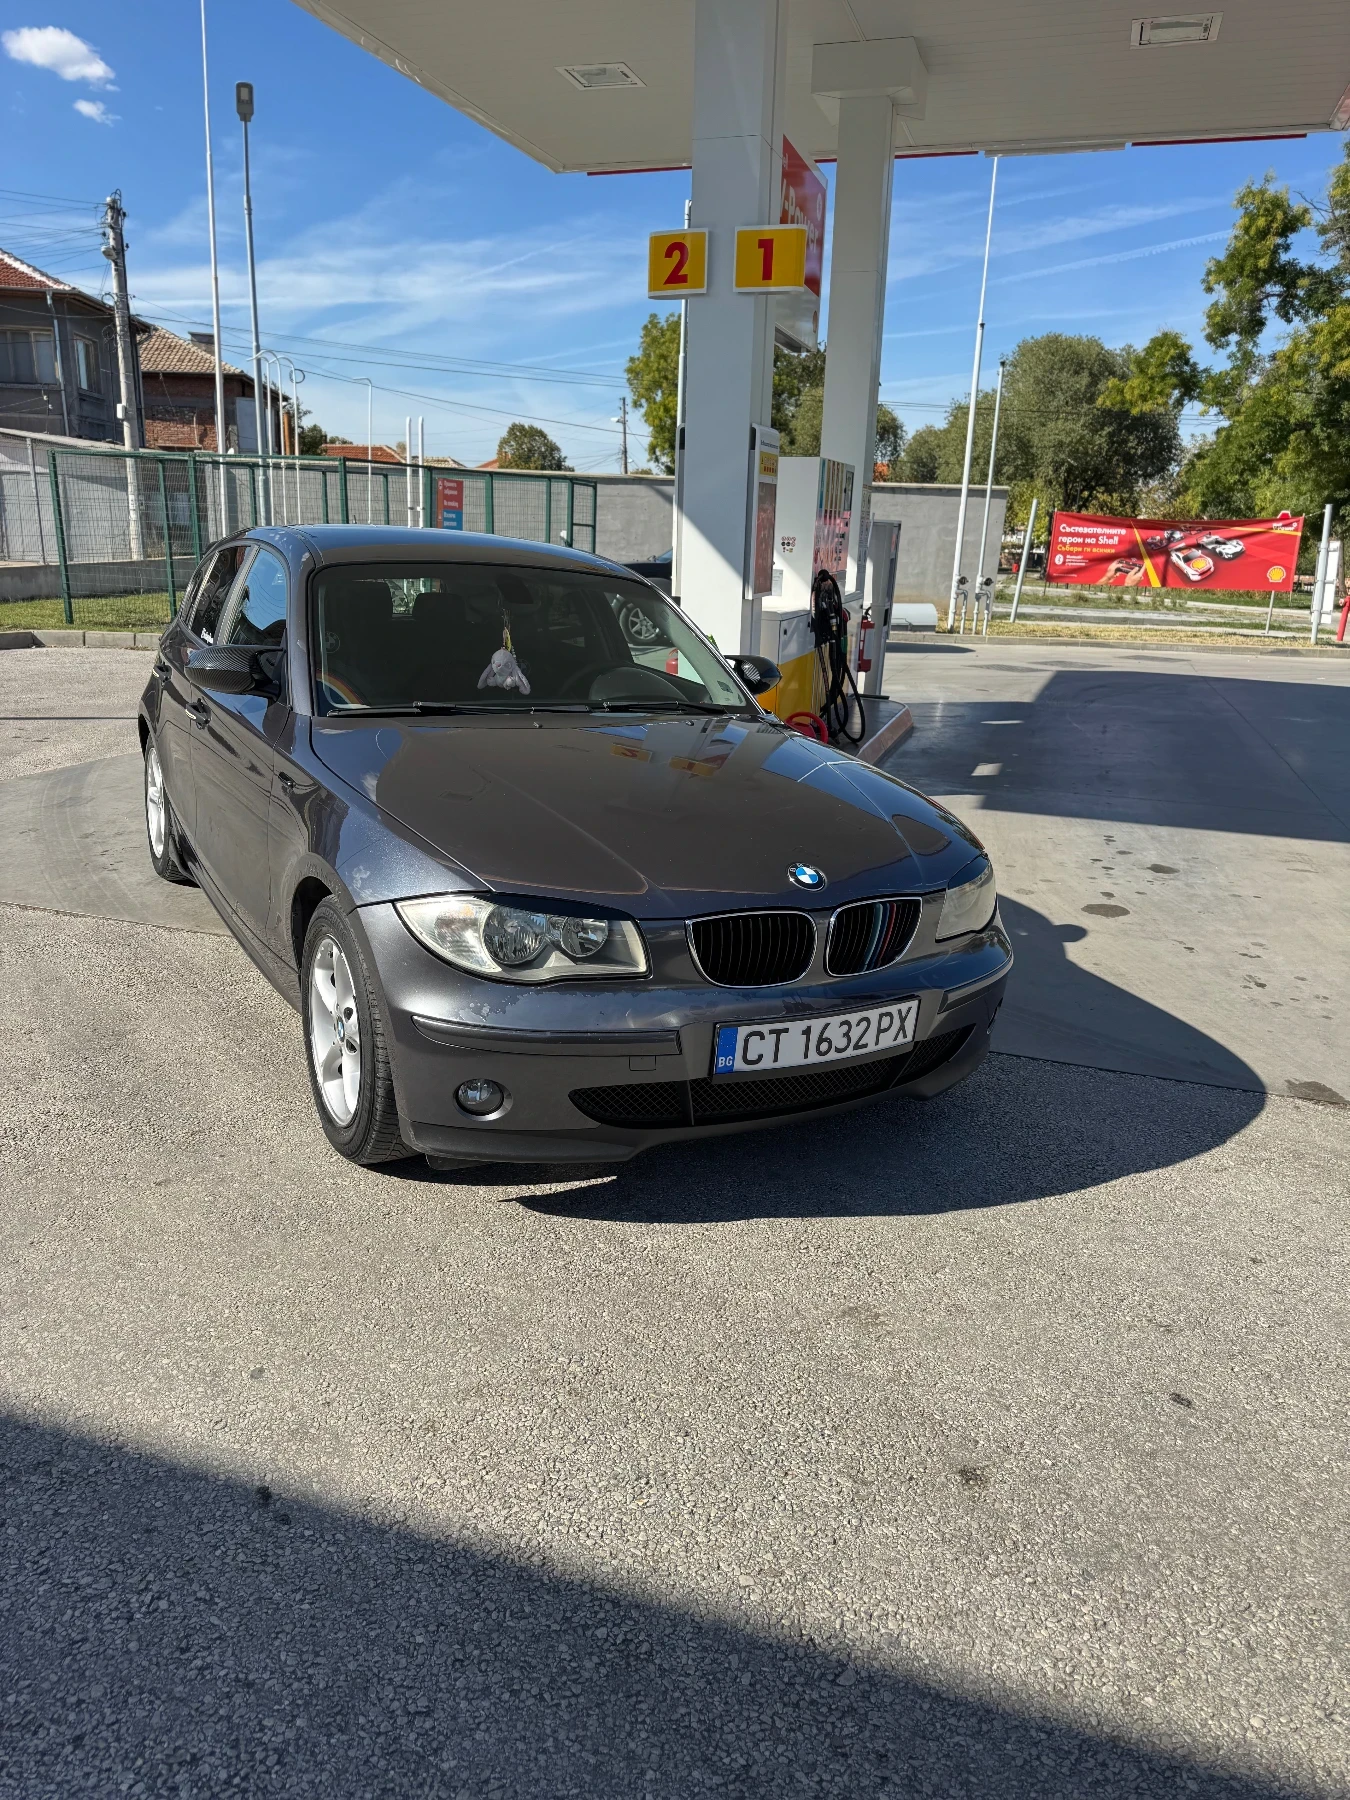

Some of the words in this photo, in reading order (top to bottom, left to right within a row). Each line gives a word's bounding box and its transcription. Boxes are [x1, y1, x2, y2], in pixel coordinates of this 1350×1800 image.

[663, 241, 689, 286] 2
[758, 238, 774, 281] 1
[1060, 523, 1127, 535] Състезателните
[1058, 536, 1083, 545] герои
[1098, 535, 1119, 545] Shell
[1057, 544, 1082, 553] Събери
[742, 1028, 789, 1066] CT
[802, 1016, 871, 1060] 1632
[874, 1006, 912, 1047] PX
[718, 1055, 733, 1069] BG
